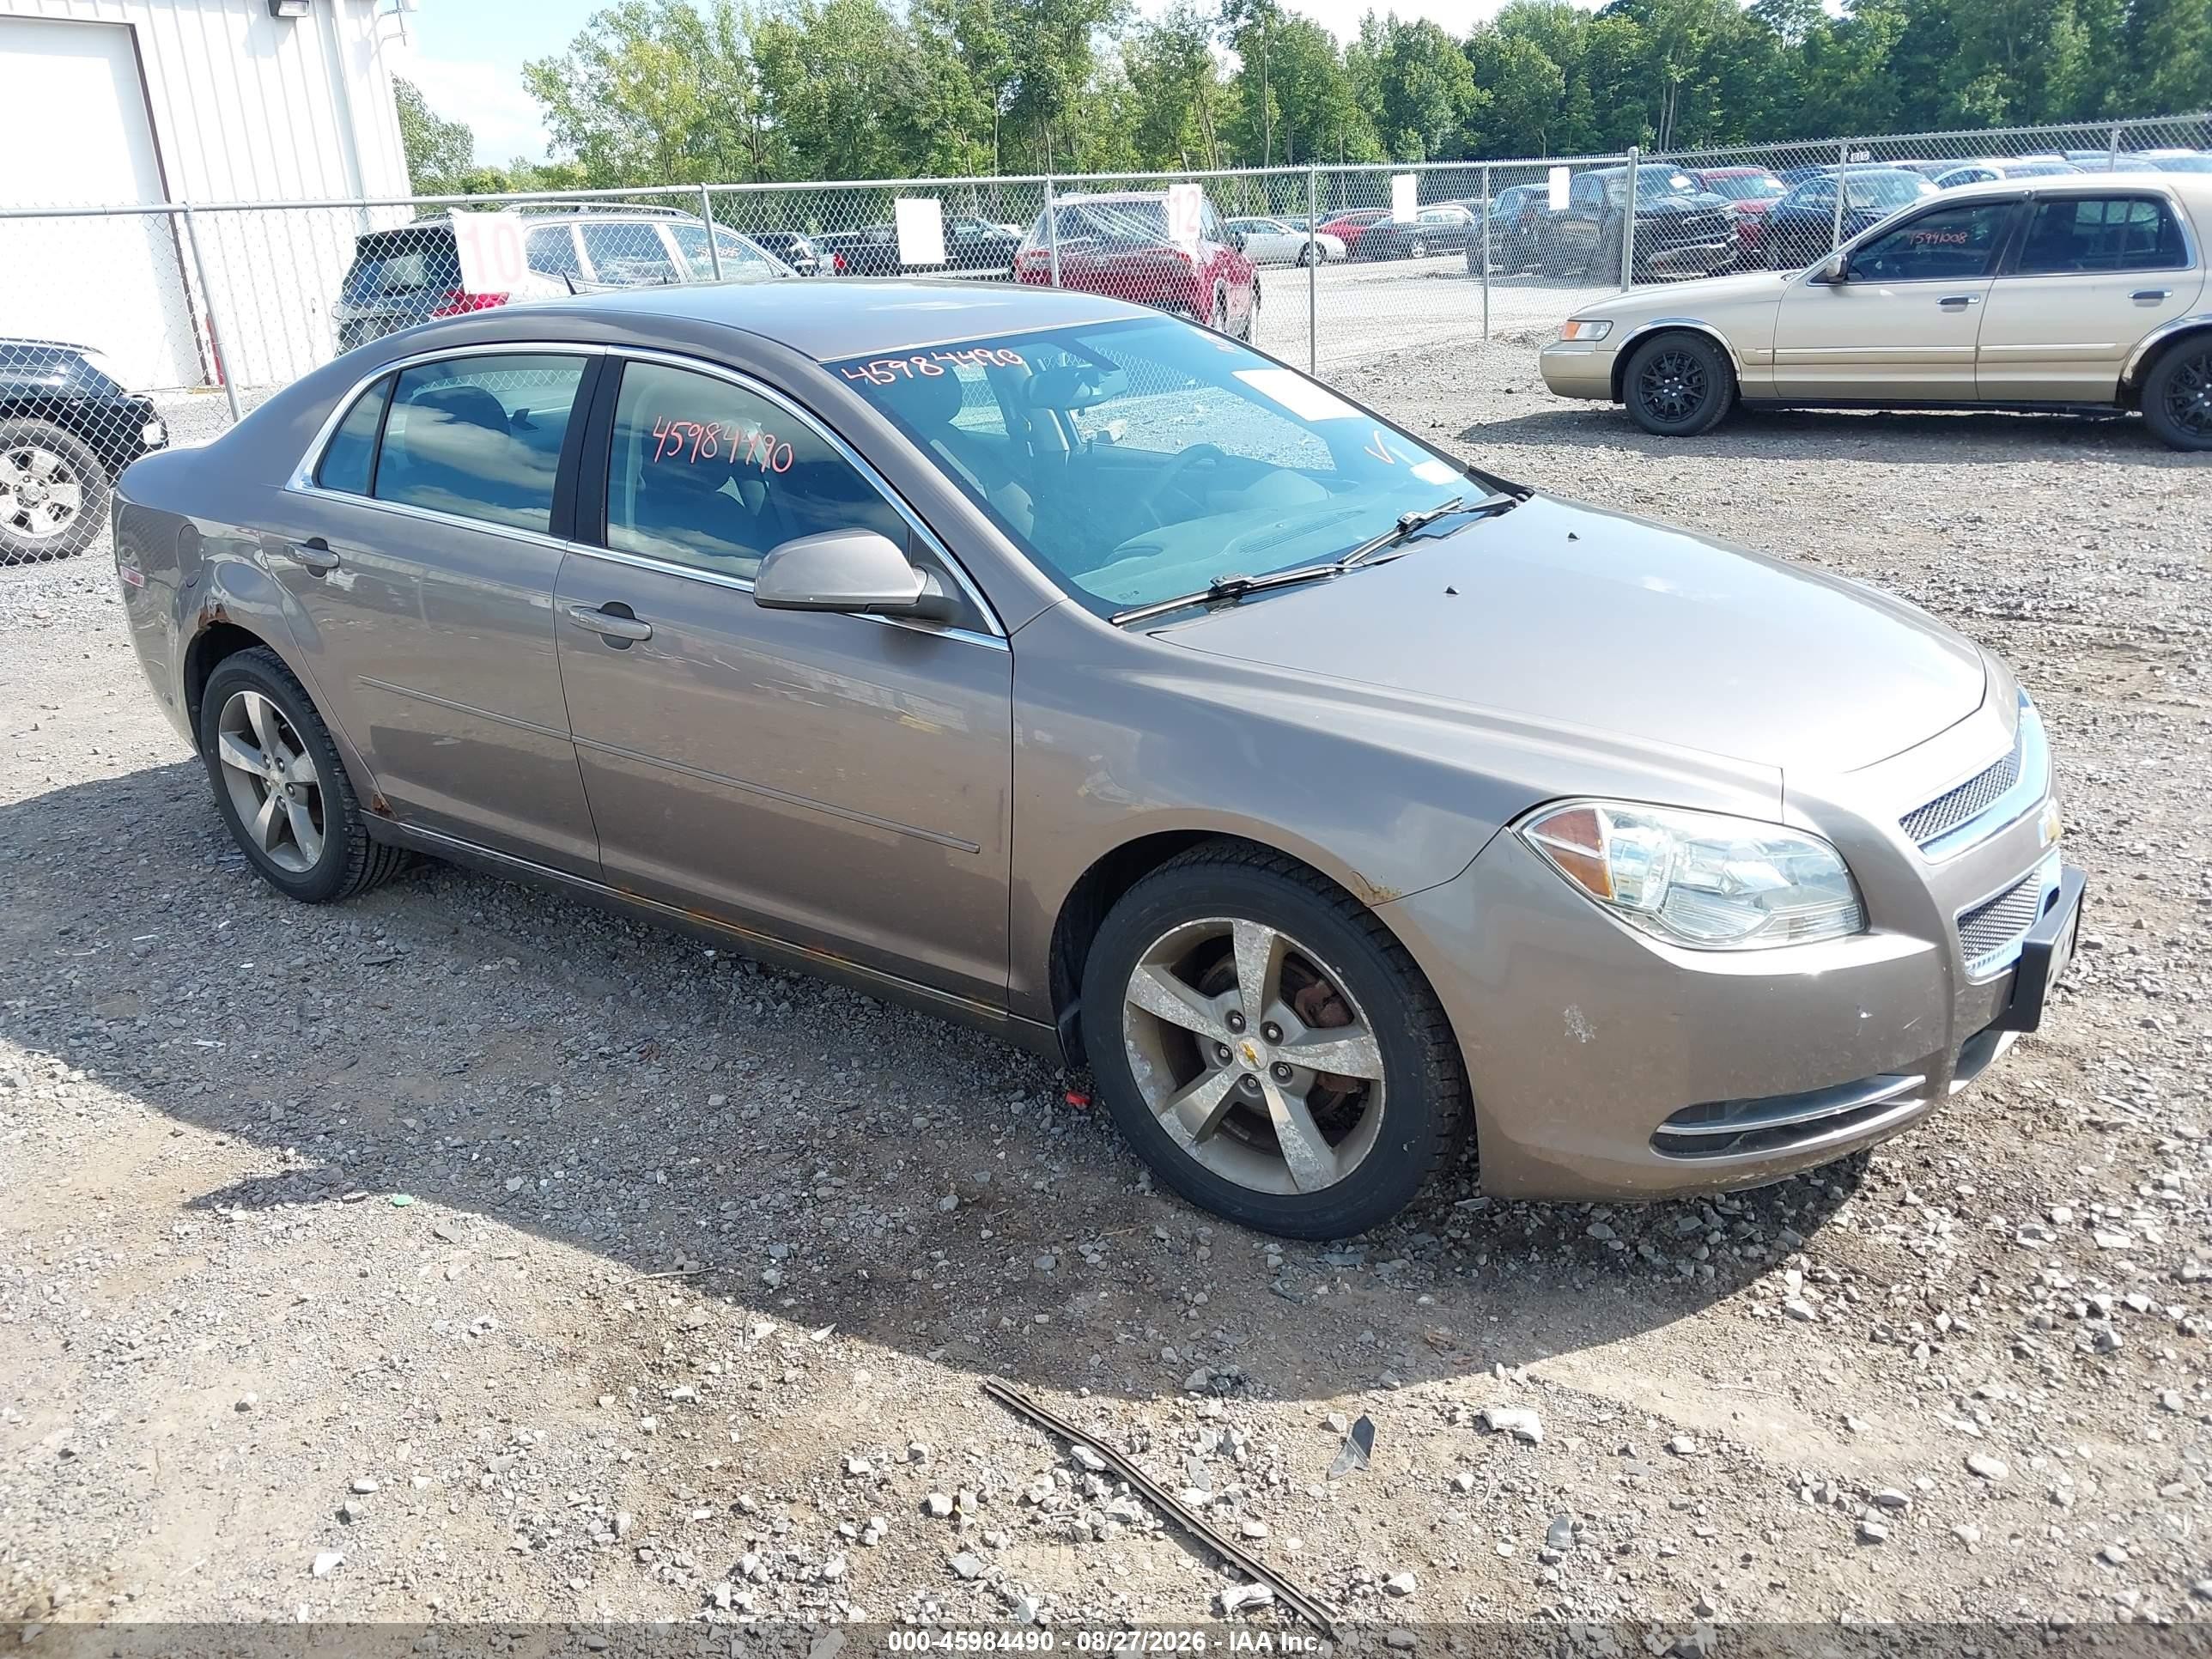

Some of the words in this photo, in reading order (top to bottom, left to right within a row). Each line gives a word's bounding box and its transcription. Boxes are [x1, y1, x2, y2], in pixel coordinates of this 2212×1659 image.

[1173, 190, 1199, 234] 12
[461, 220, 523, 285] 10
[841, 349, 1024, 386] 45984490
[652, 416, 794, 474] 45984490
